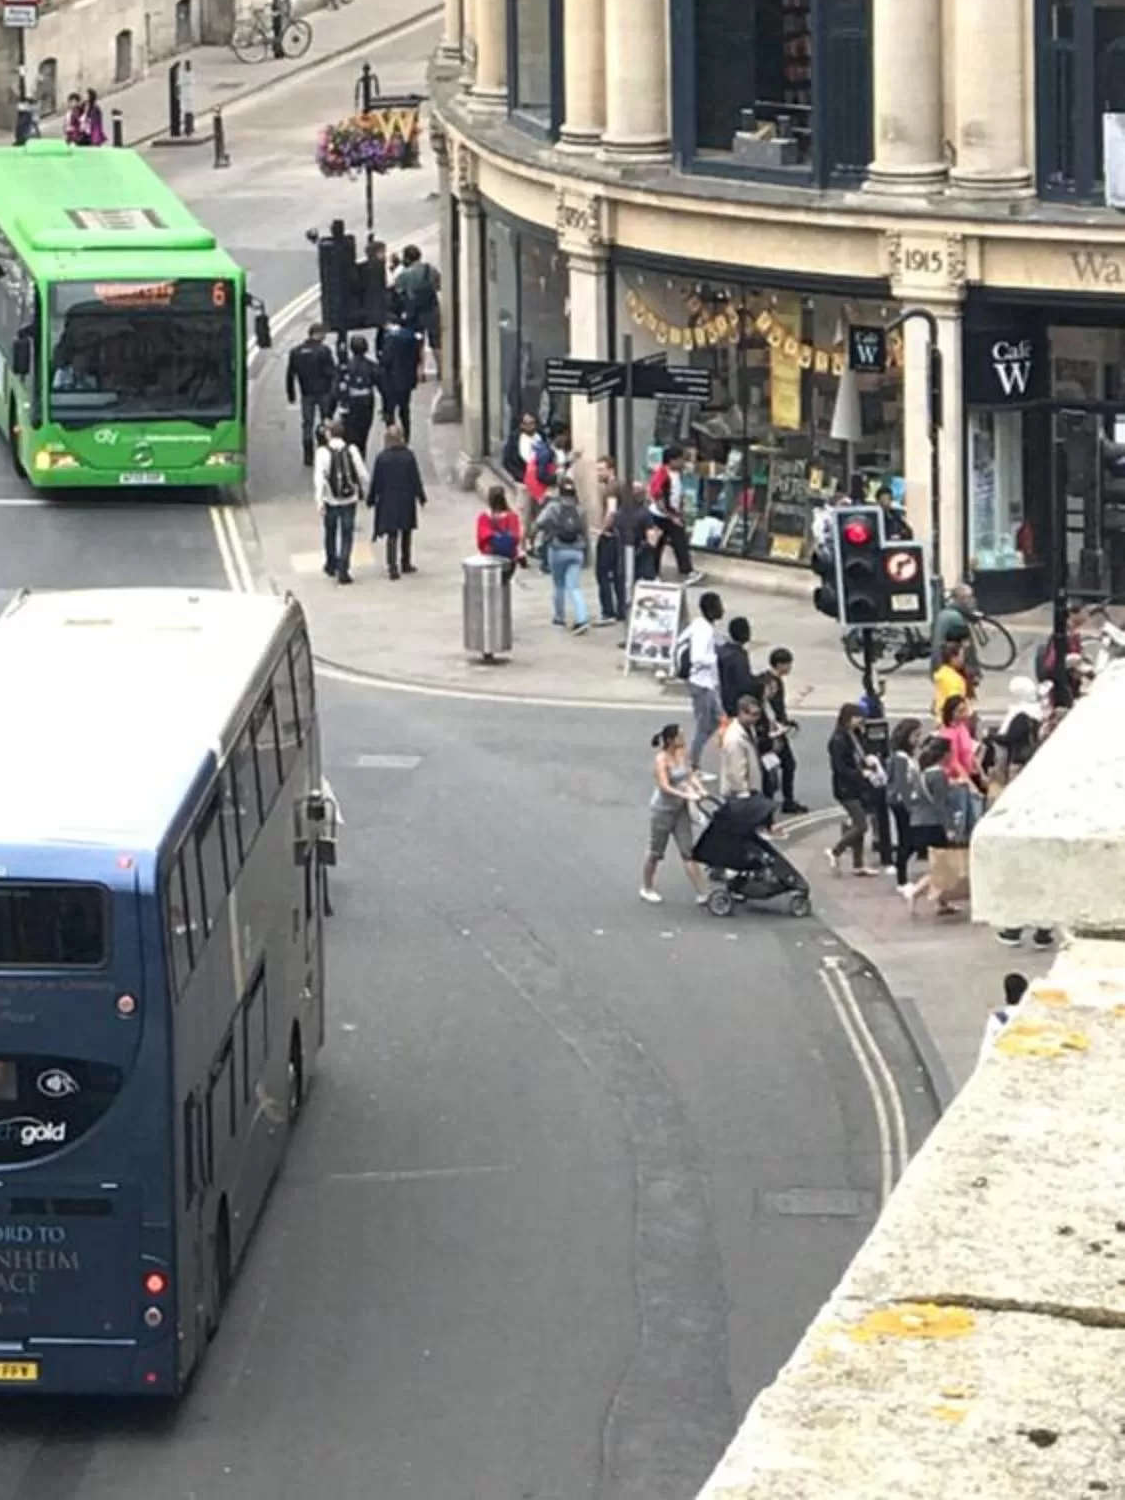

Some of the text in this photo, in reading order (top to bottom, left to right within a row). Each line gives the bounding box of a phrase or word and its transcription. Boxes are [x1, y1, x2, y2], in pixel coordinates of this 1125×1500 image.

[905, 249, 943, 274] 1915
[211, 280, 226, 308] 6
[857, 344, 879, 364] W
[992, 361, 1031, 395] W
[20, 1121, 66, 1146] gold
[38, 1226, 66, 1243] TO
